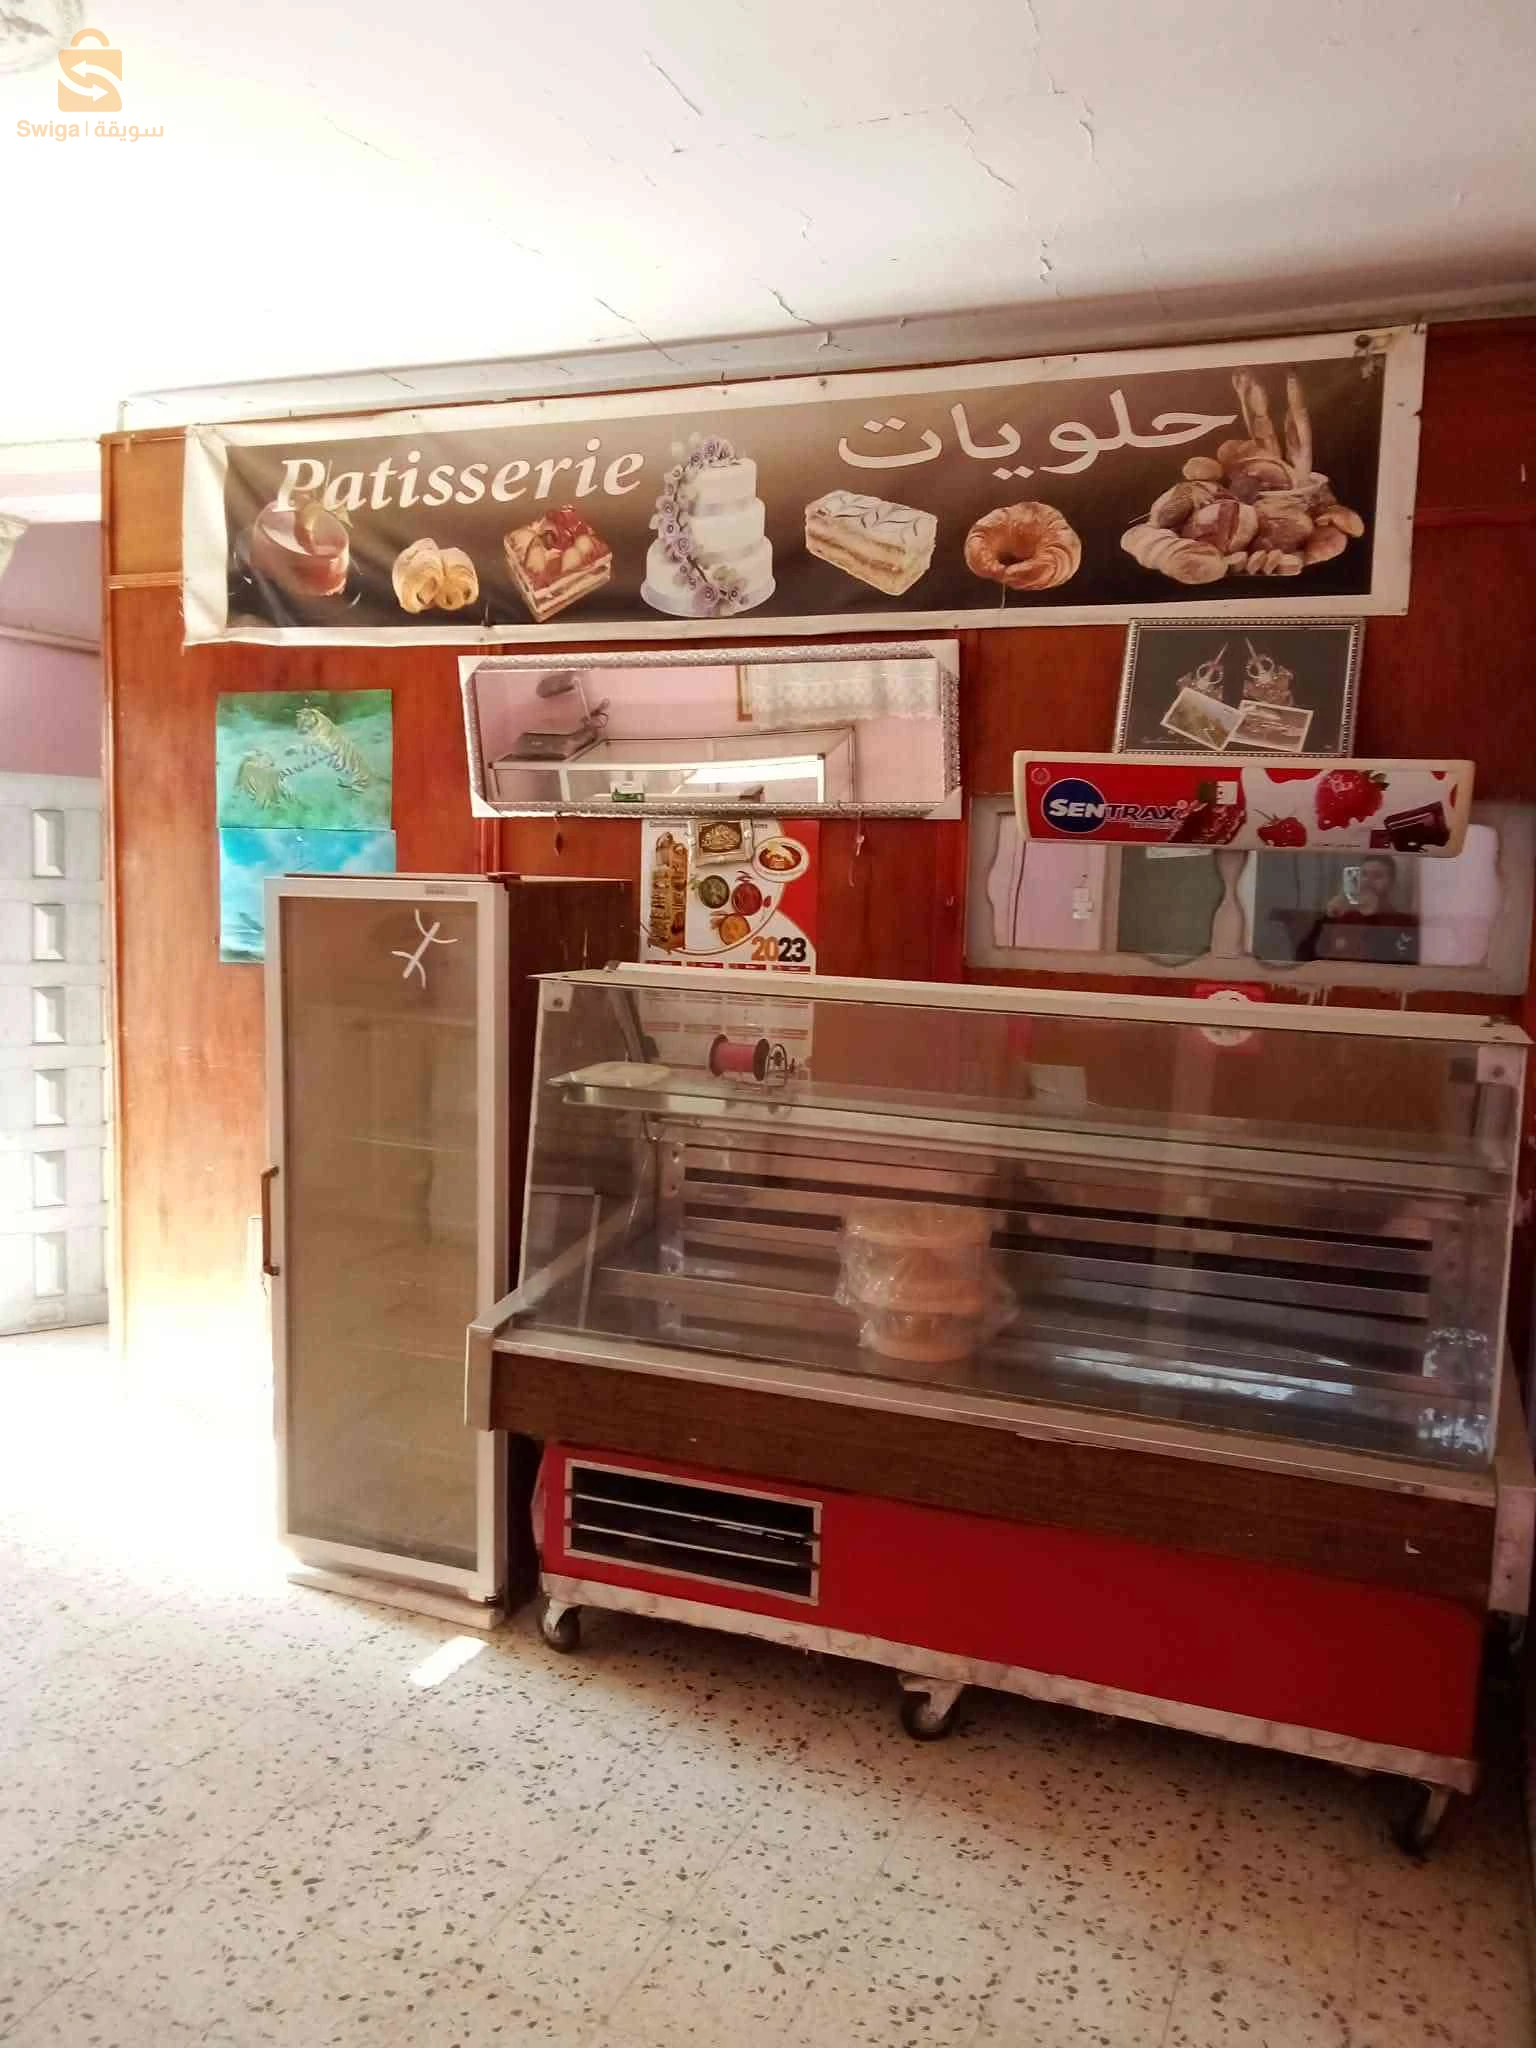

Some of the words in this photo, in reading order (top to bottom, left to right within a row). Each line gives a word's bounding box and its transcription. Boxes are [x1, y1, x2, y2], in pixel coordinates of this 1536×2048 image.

[838, 389, 1238, 480] حلويات
[272, 438, 644, 513] Patisserie
[1049, 798, 1178, 820] SENTRAX
[751, 936, 807, 963] 2023
